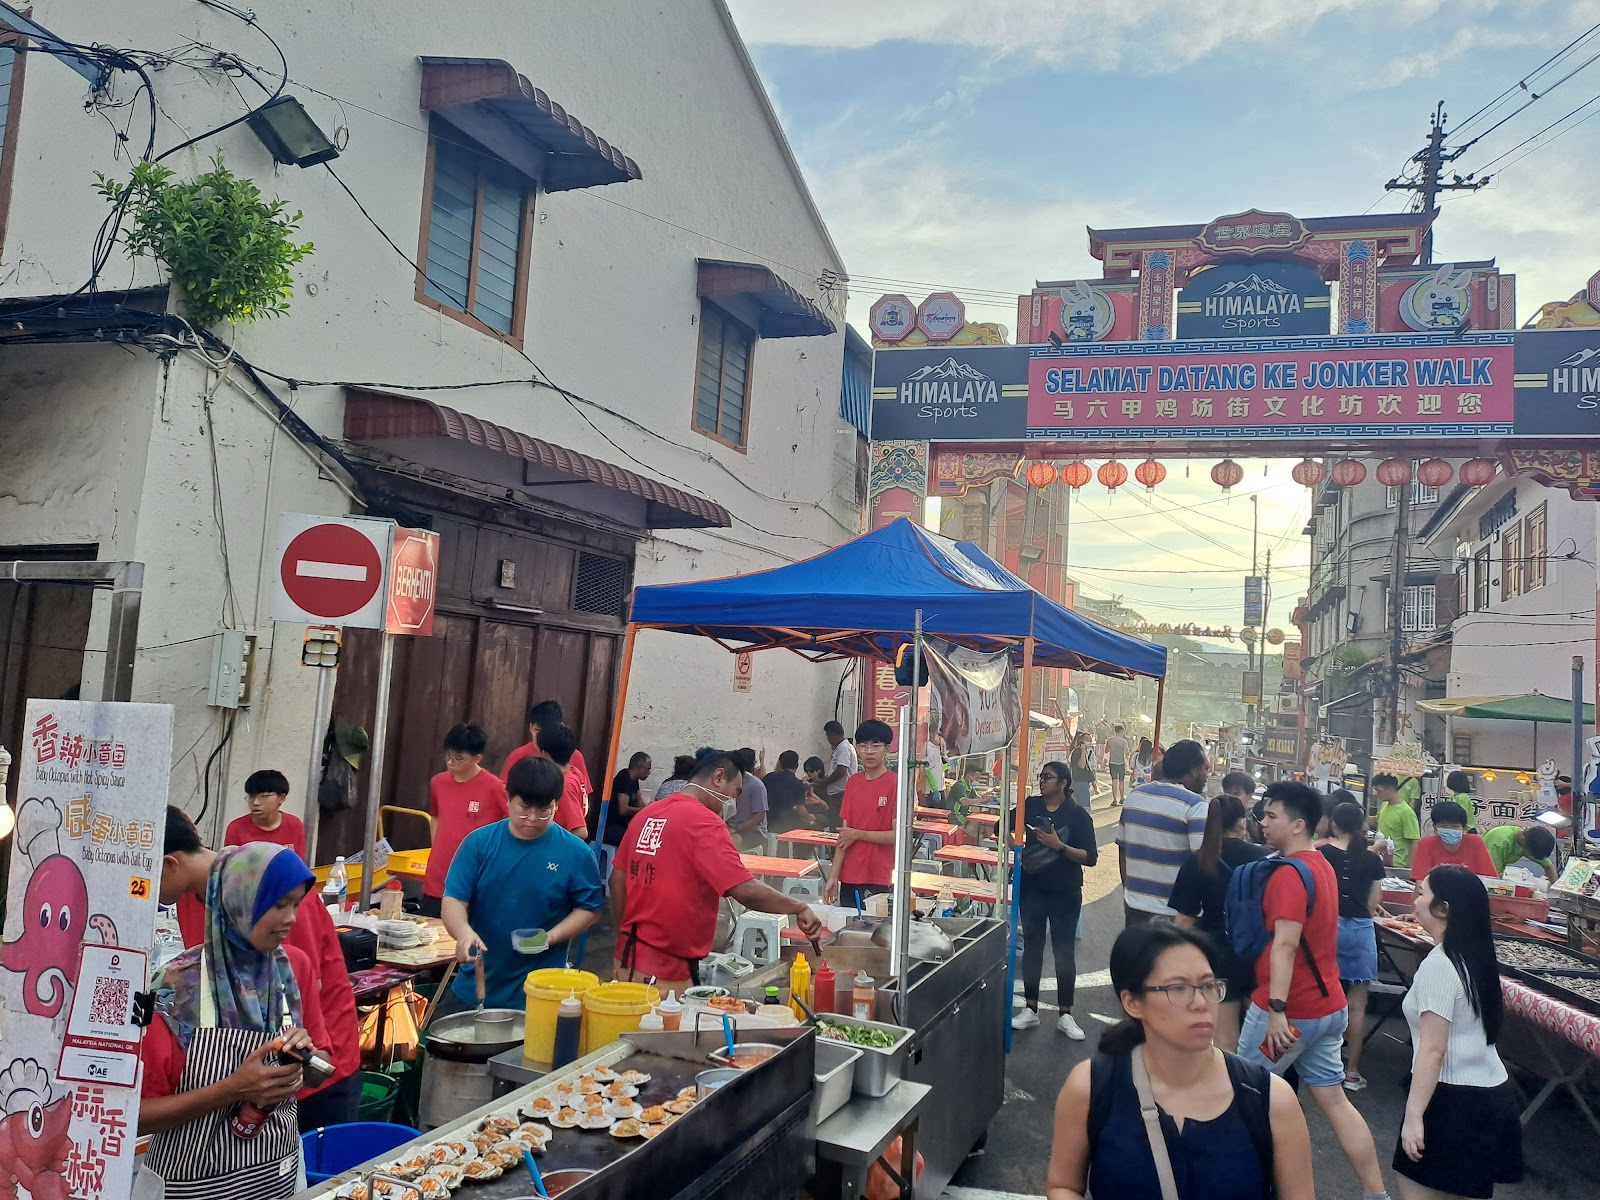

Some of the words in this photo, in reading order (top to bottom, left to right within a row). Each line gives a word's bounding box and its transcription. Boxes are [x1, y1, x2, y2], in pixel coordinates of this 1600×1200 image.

[1205, 293, 1301, 317] HIMALAYA
[1222, 315, 1281, 334] Sports
[1045, 365, 1152, 394] SELAMAT
[1157, 362, 1256, 393] DATANG
[1262, 362, 1297, 390] KE
[1302, 358, 1409, 389] JONKER
[1414, 356, 1493, 387] WALK
[901, 380, 998, 404] HIMALAYA
[917, 405, 978, 424] Sports
[1052, 392, 1482, 420] 马六甲鸡场街文化坊欢迎您
[395, 565, 431, 600] BERHENTI
[975, 717, 992, 740] Oyster
[32, 713, 126, 769] 香辣小章鱼
[36, 766, 48, 784] Baby
[49, 767, 70, 785] Octopus
[71, 770, 83, 784] with
[84, 770, 93, 785] Hot
[95, 770, 109, 789] Spicy
[110, 771, 126, 787] Sauce
[65, 794, 154, 847] 咸蛋小章鱼
[82, 846, 94, 864] Baby
[95, 847, 116, 866] Octopus
[117, 850, 130, 866] with
[131, 851, 141, 867] Salt
[142, 853, 153, 872] Egg
[131, 879, 146, 896] 25
[72, 1038, 97, 1046] MALAYSIA
[98, 1041, 125, 1050] NATIONAL
[87, 1064, 108, 1075] MAE
